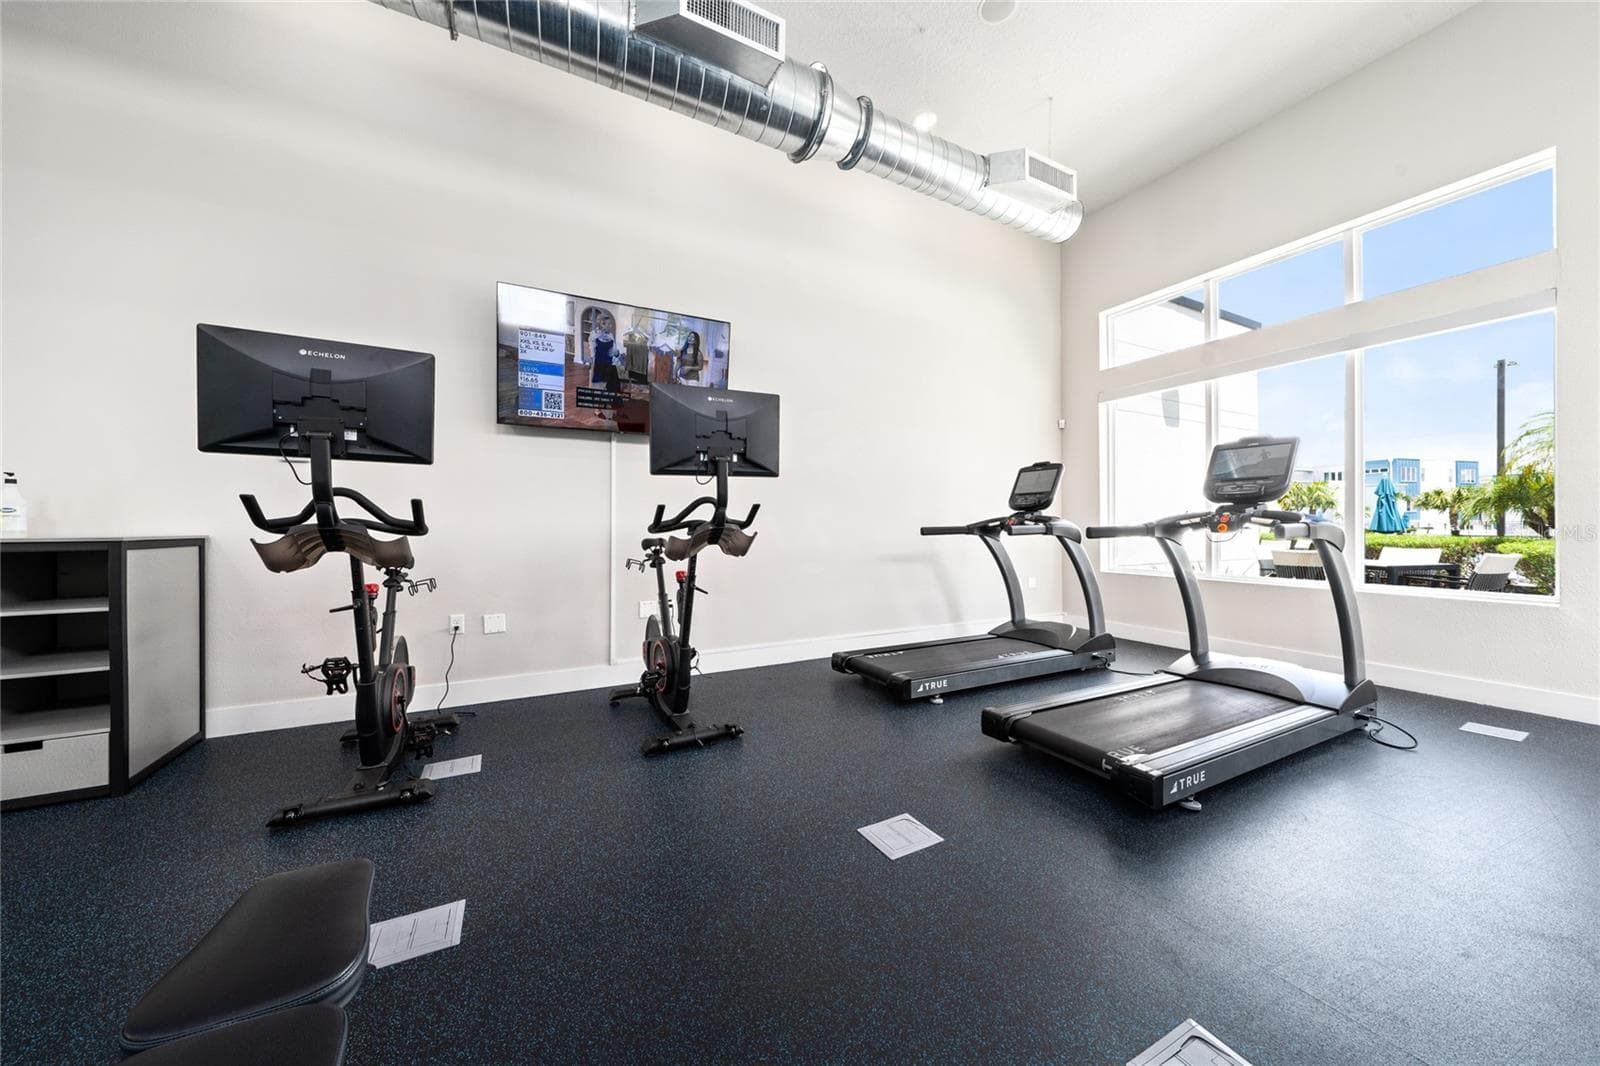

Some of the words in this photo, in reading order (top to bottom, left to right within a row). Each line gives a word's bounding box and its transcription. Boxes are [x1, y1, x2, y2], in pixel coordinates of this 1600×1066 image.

[307, 350, 346, 360] ECHELON
[925, 680, 948, 690] TRUE
[1179, 770, 1206, 790] TRUE
